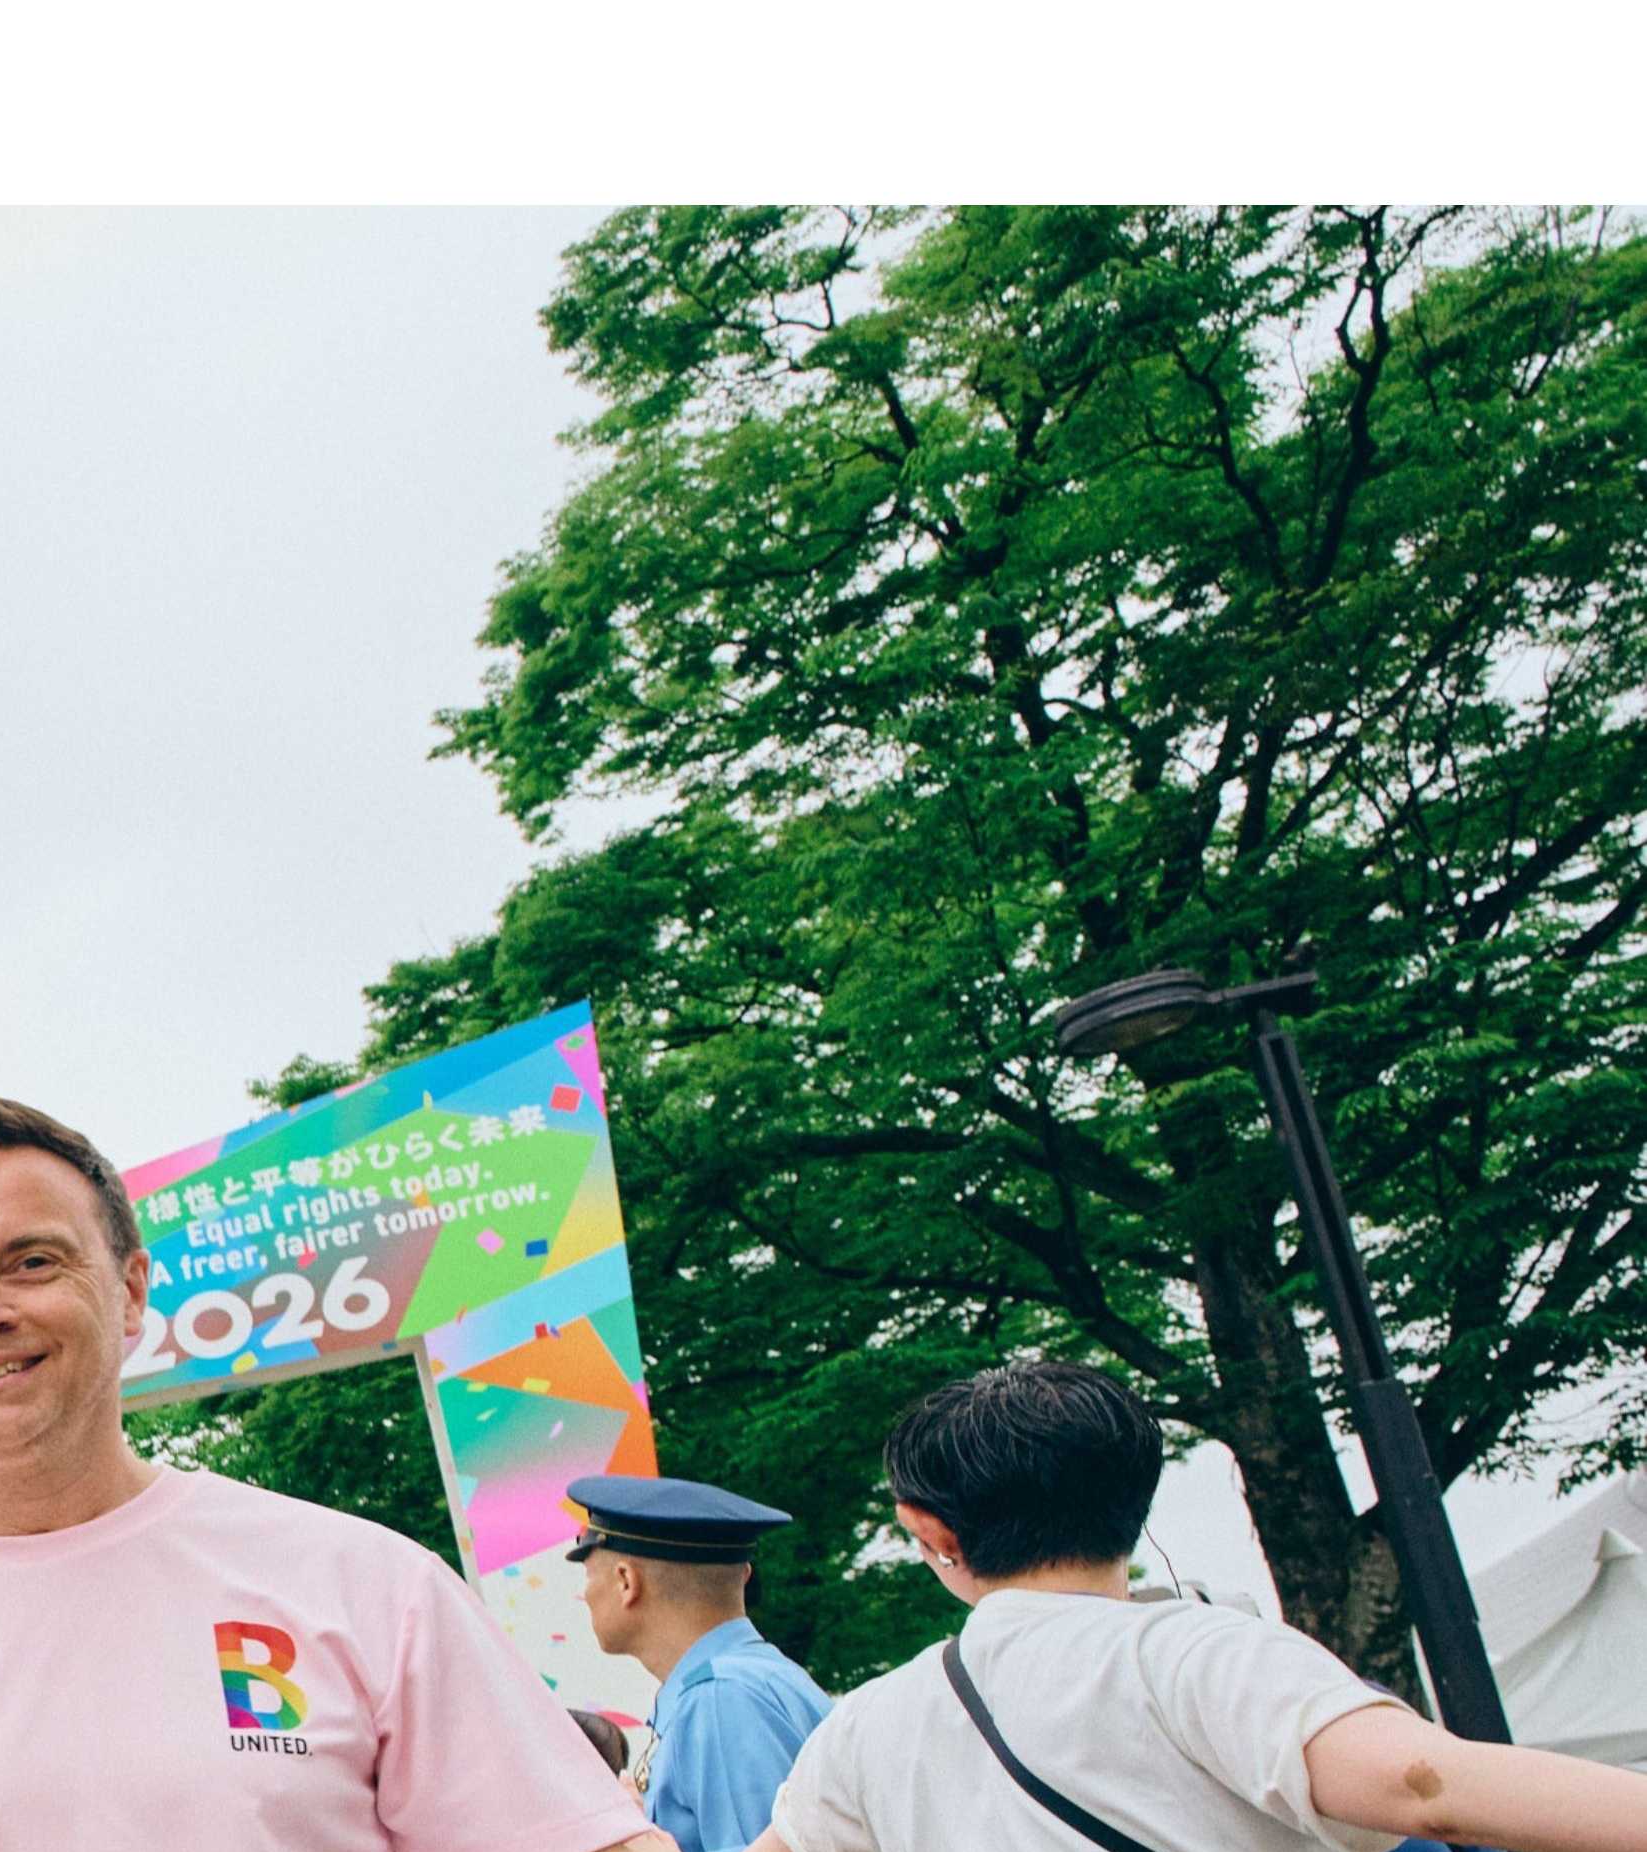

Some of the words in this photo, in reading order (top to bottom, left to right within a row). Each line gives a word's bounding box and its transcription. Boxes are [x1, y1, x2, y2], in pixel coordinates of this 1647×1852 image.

[135, 1104, 547, 1224] 様性と平等がひらく未来
[185, 1204, 274, 1249] Equal
[284, 1180, 382, 1227] rights
[391, 1157, 494, 1203] today.
[150, 1262, 174, 1289] A
[179, 1248, 269, 1283] freer,
[274, 1220, 364, 1260] fairer
[374, 1184, 551, 1239] tomorrow.
[119, 1256, 391, 1378] 2026
[213, 1621, 308, 1731] B
[230, 1734, 313, 1757] UNITED.
